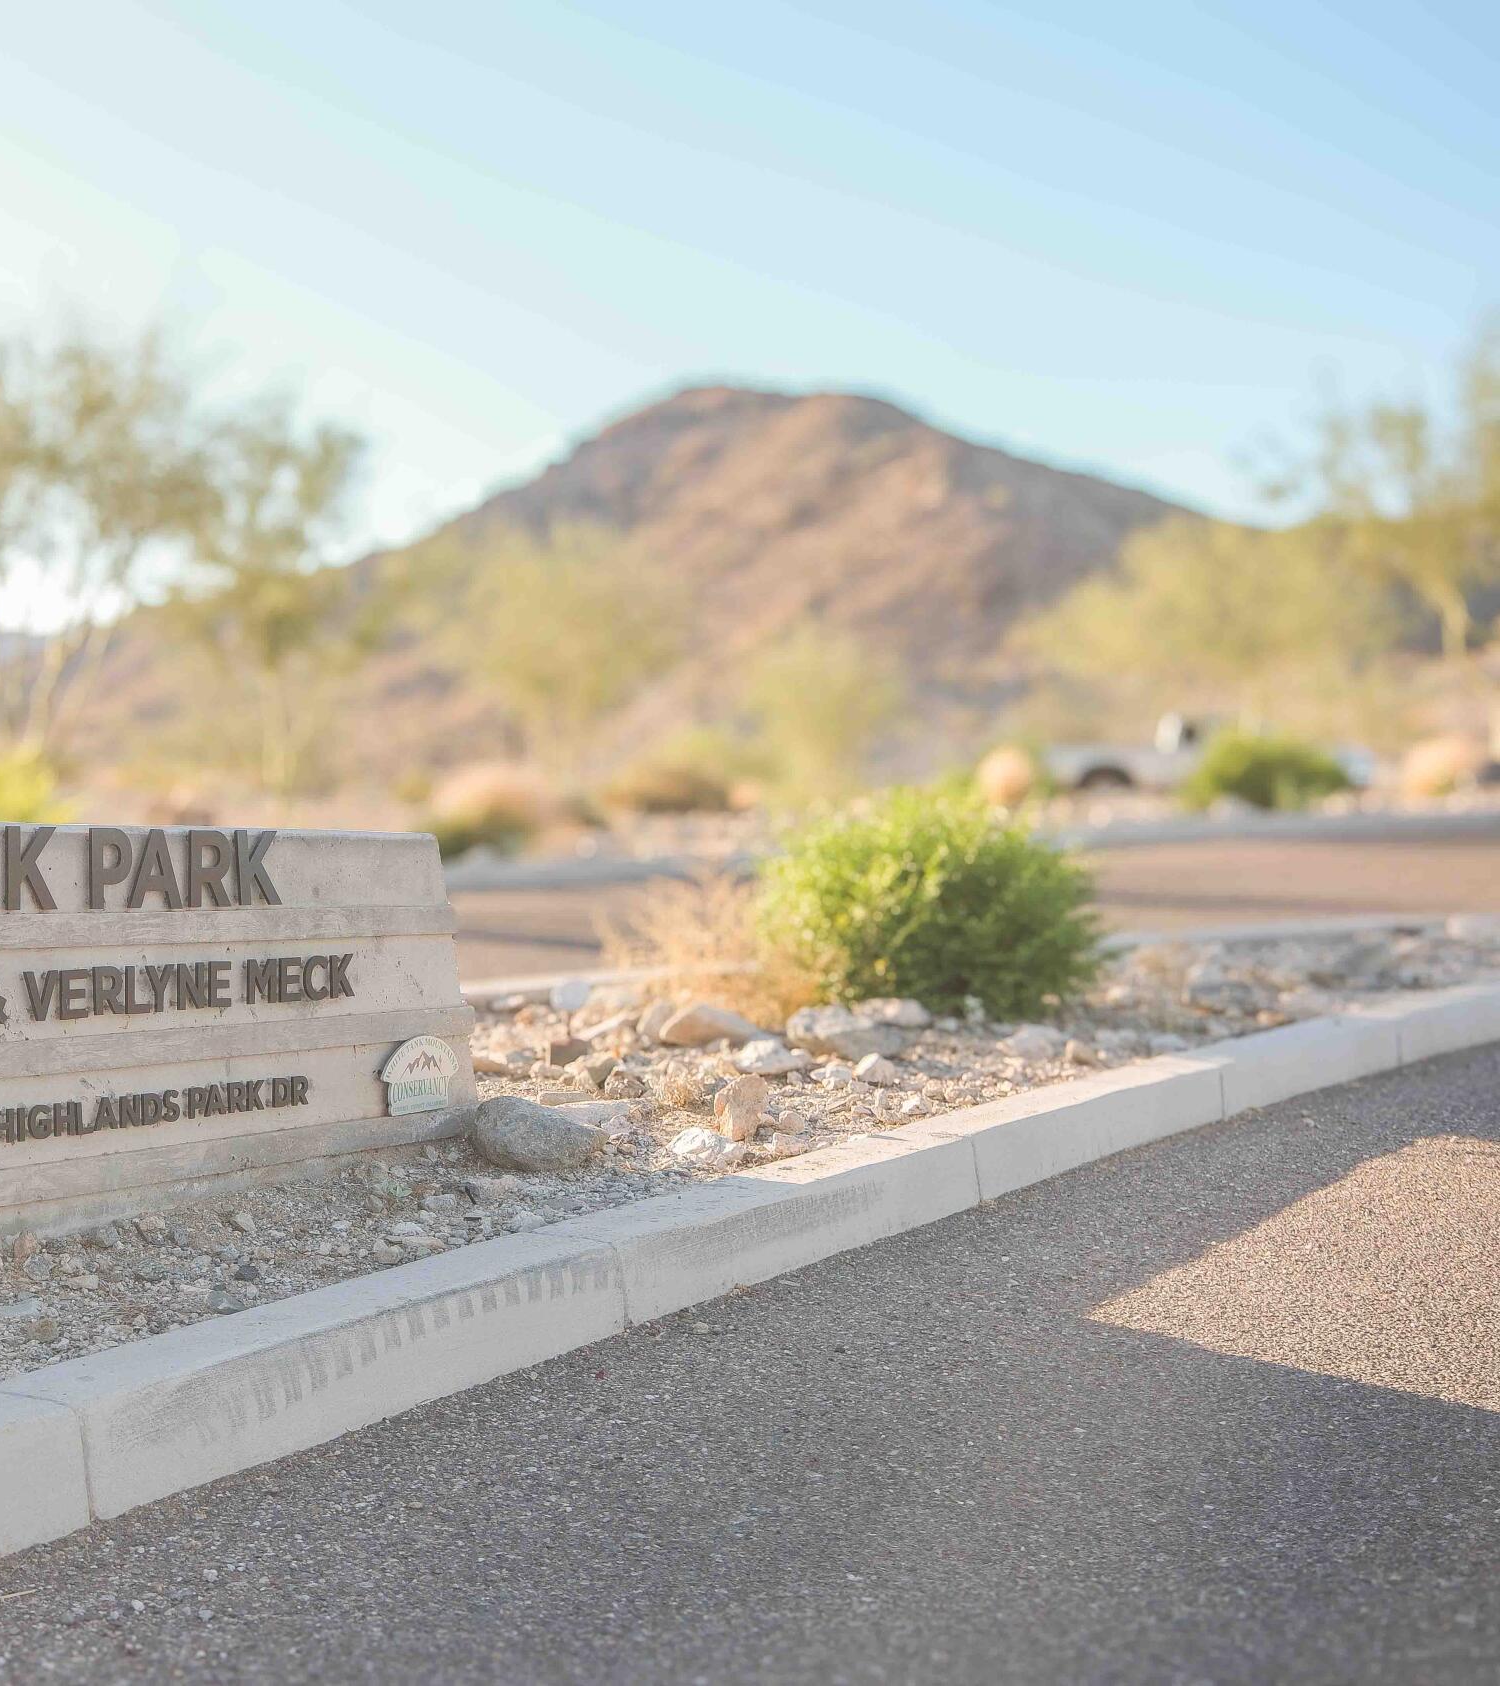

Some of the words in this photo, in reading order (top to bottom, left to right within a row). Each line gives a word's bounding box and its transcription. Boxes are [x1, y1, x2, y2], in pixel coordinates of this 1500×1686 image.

[88, 827, 283, 910] PARK
[22, 960, 233, 1022] VERLYNE
[246, 953, 356, 1005] MECK
[187, 1079, 265, 1120] PARK
[270, 1075, 310, 1109] DR
[392, 1076, 448, 1103] CONSERVANCY
